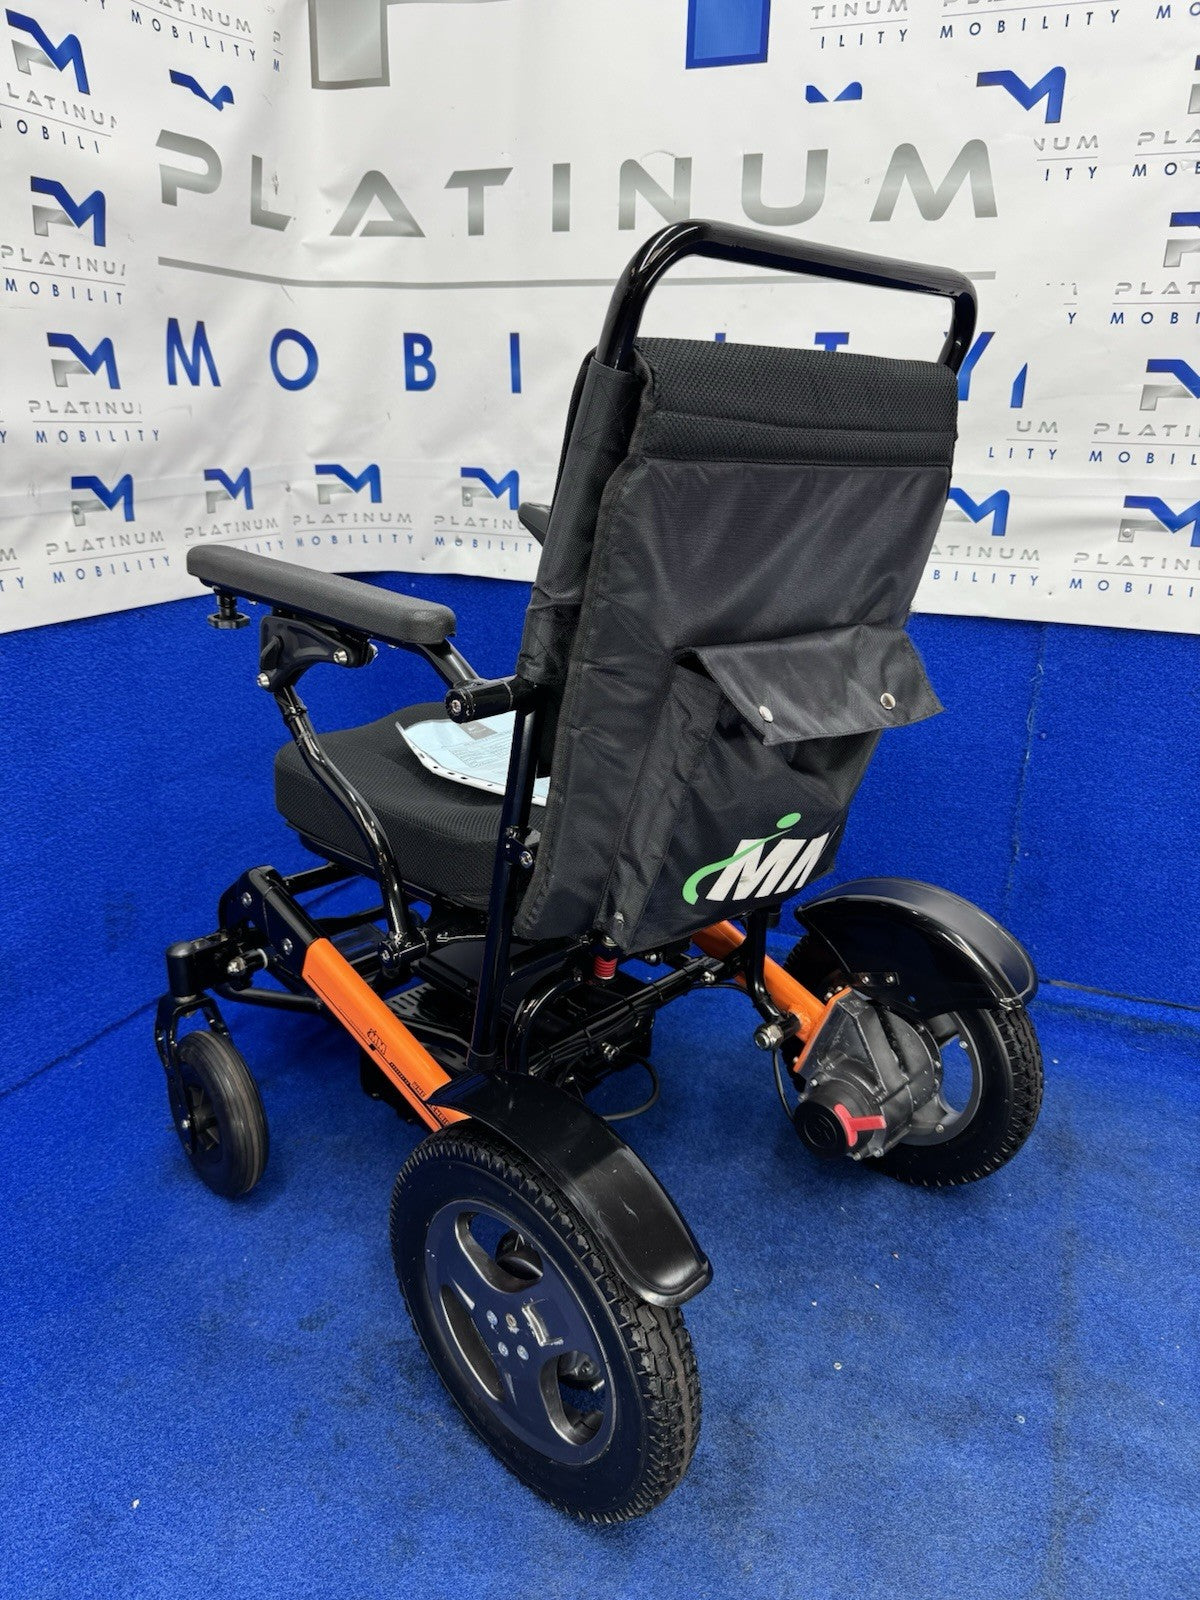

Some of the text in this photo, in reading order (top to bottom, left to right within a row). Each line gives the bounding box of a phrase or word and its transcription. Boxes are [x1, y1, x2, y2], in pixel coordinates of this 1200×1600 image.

[131, 9, 256, 61] MOBILITY
[940, 9, 1120, 39] MOBILITY
[821, 29, 908, 49] ILITY
[0, 118, 99, 153] OBILI
[156, 128, 997, 239] PLATINUM
[5, 278, 122, 305] MOBILIT
[36, 429, 160, 443] MOBILITY
[184, 518, 279, 538] PLATINUM
[293, 511, 412, 525] PLATINUM
[46, 530, 164, 556] PLATINUM
[297, 534, 414, 547] MOBILITY
[53, 556, 170, 584] MOBILITY
